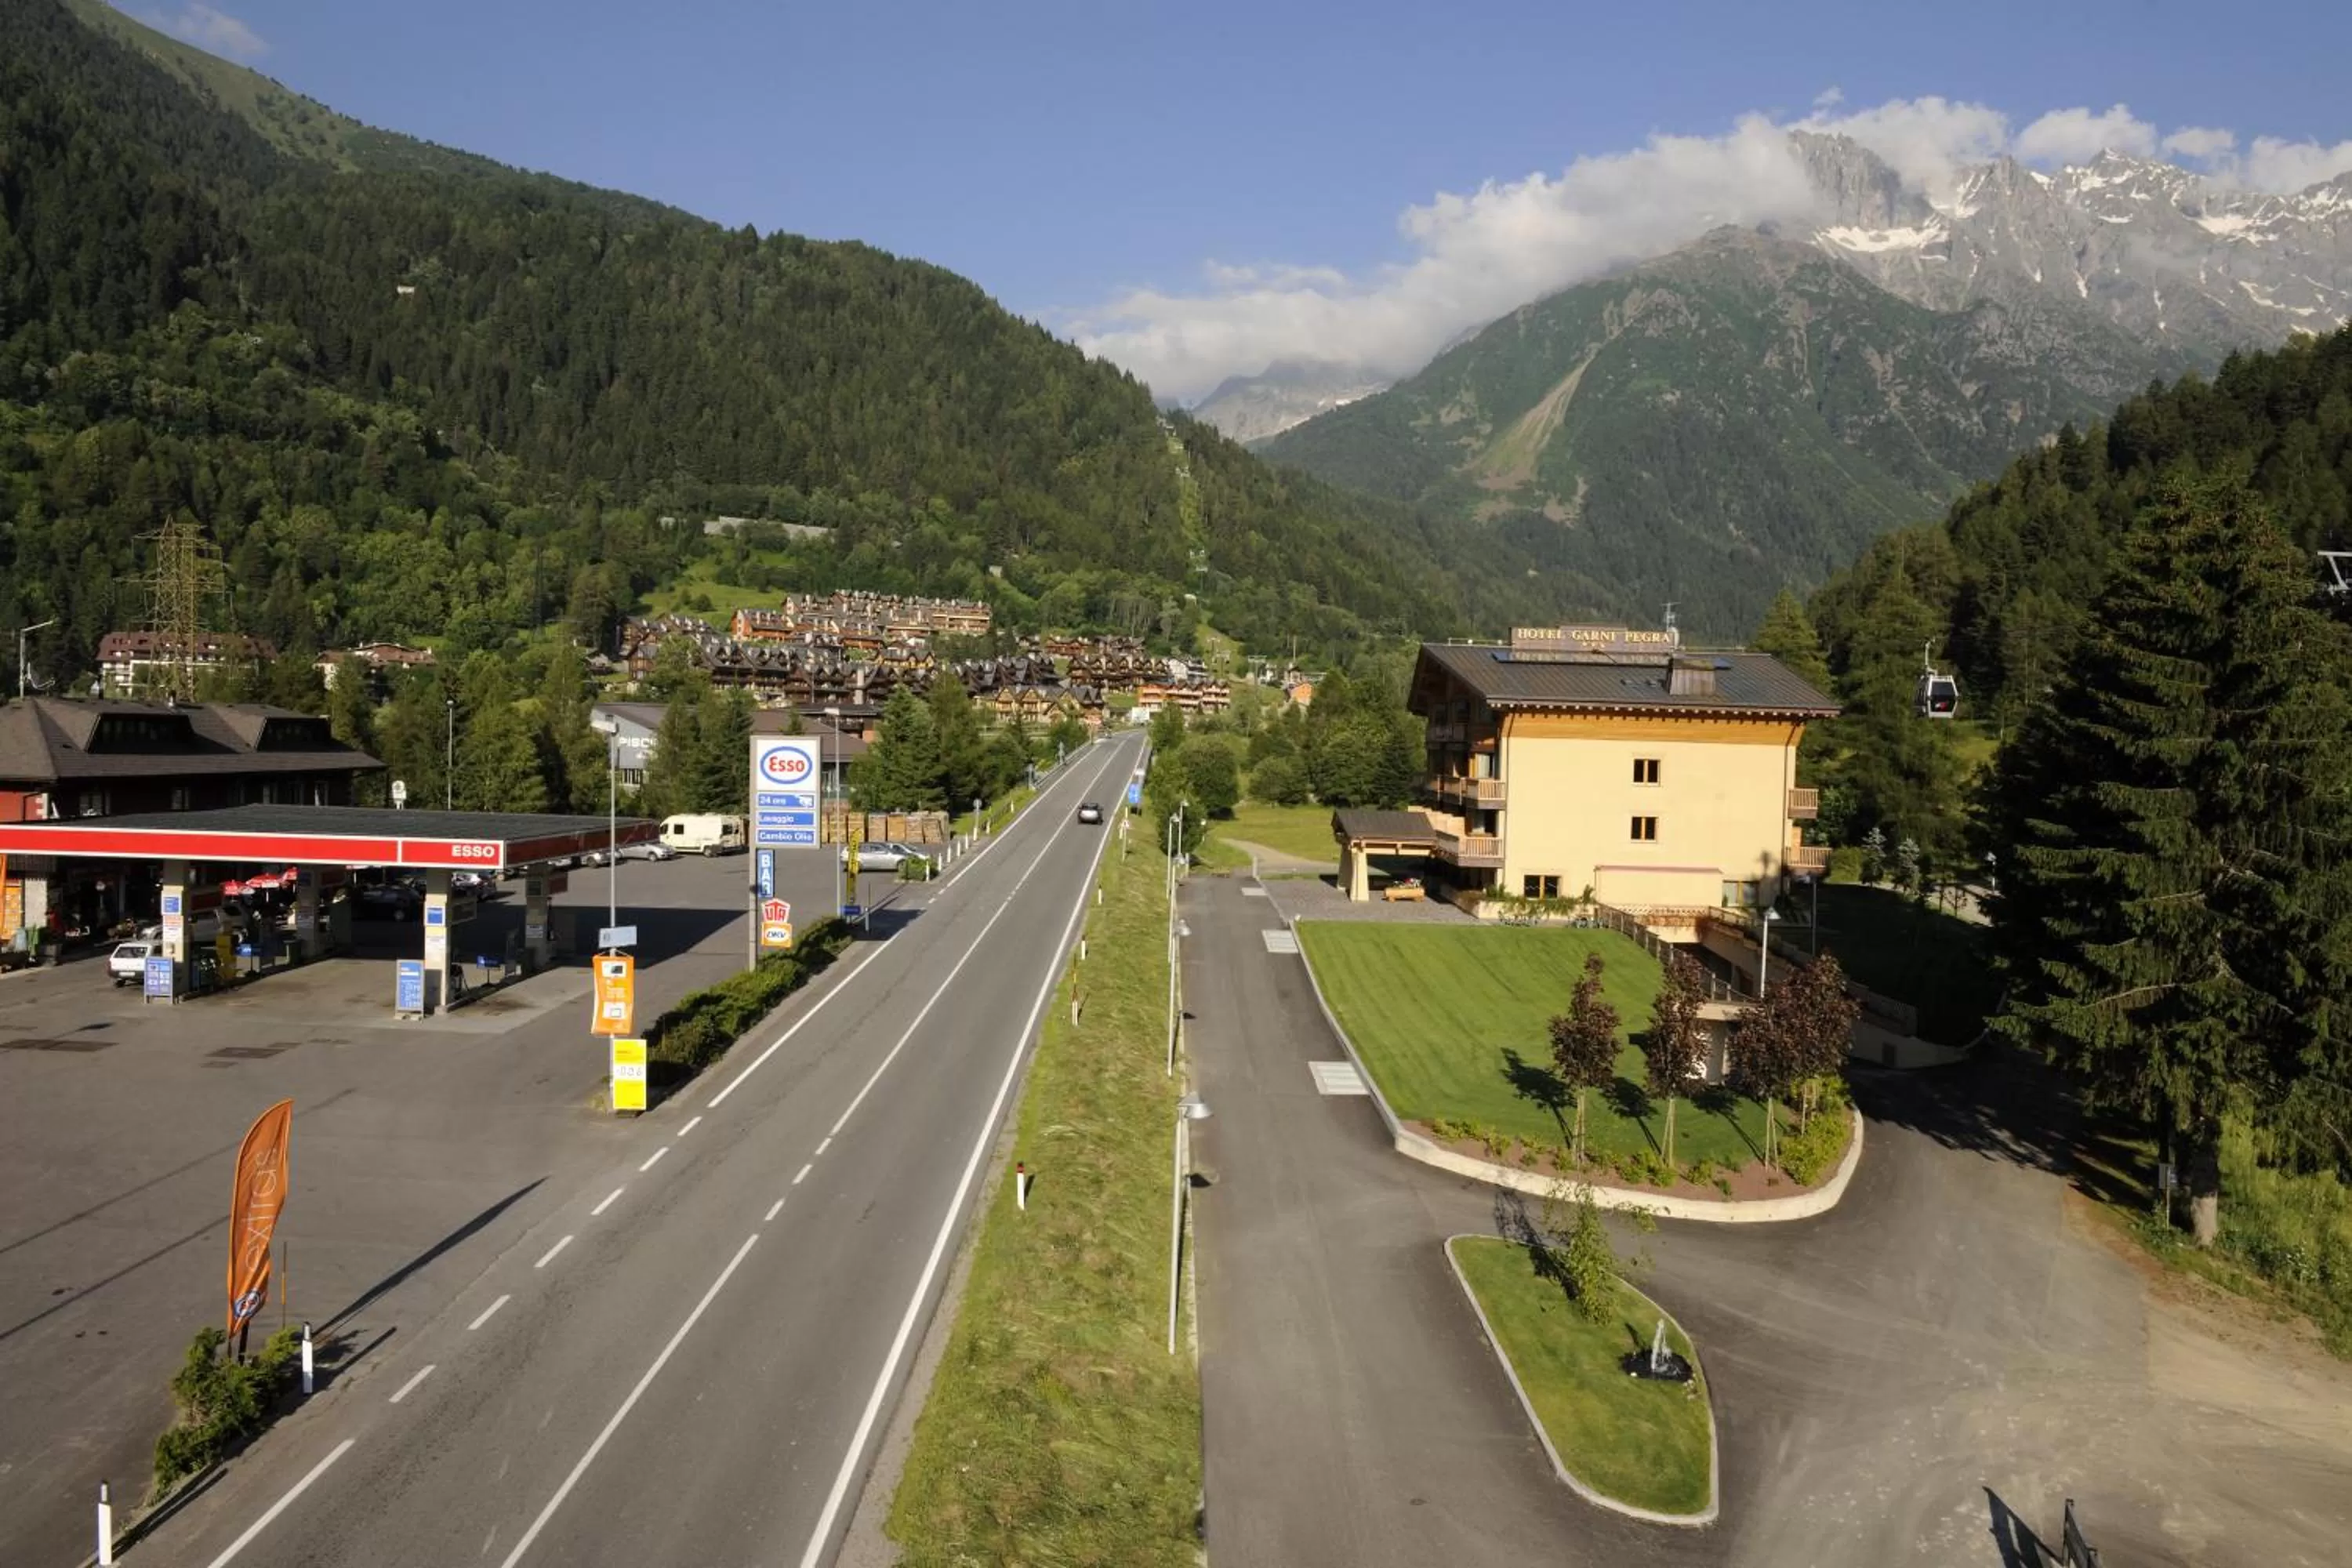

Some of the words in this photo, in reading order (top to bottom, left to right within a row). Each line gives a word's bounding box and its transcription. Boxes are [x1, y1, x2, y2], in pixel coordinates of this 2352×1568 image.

[1518, 629, 1564, 639] HOTEL
[1572, 630, 1616, 641] GARNI
[768, 756, 805, 772] Esso
[759, 815, 794, 823] Lavaggio
[760, 832, 793, 840] Cambio
[452, 844, 495, 857] ESSO
[761, 854, 771, 895] BAR
